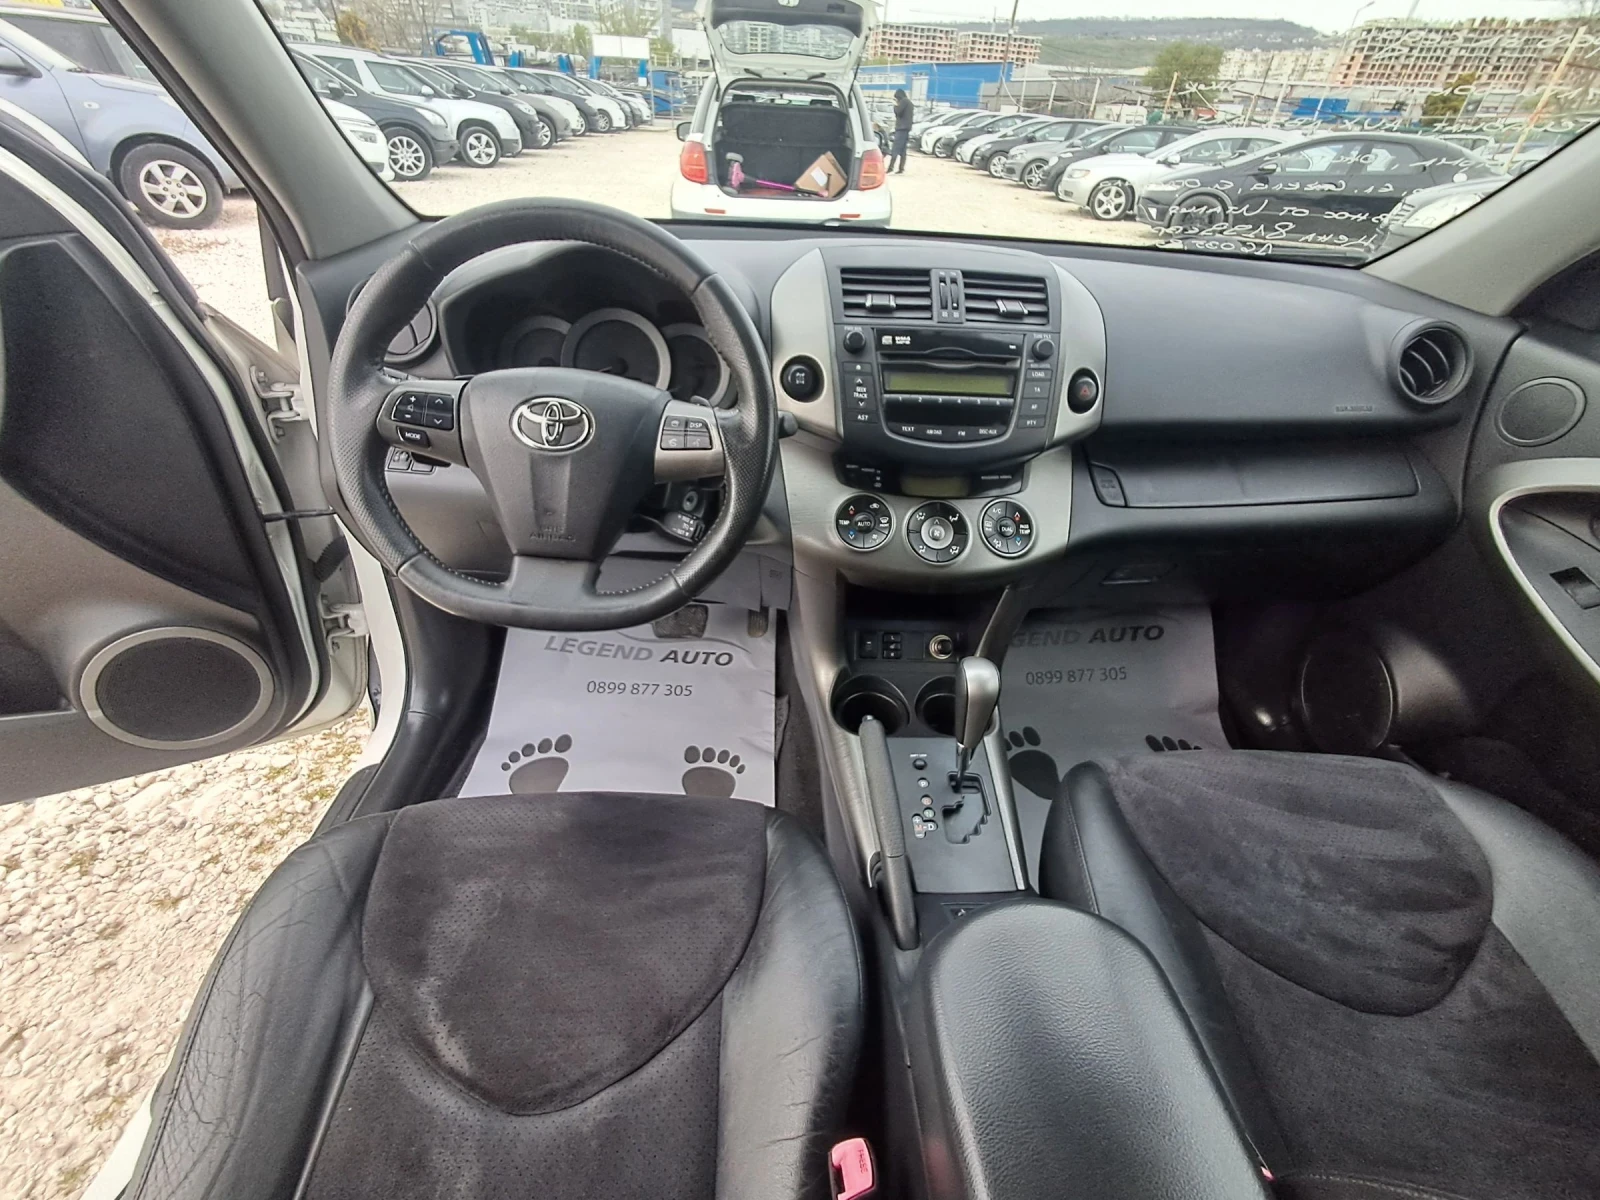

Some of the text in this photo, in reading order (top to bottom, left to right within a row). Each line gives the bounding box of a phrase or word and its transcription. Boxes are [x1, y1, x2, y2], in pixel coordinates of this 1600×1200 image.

[405, 431, 421, 440] MODE
[1011, 625, 1164, 648] GEND AUTO
[544, 635, 734, 666] LEGEND AUTO
[1025, 667, 1127, 685] 0899 877 305
[586, 680, 693, 697] 0899 877 305
